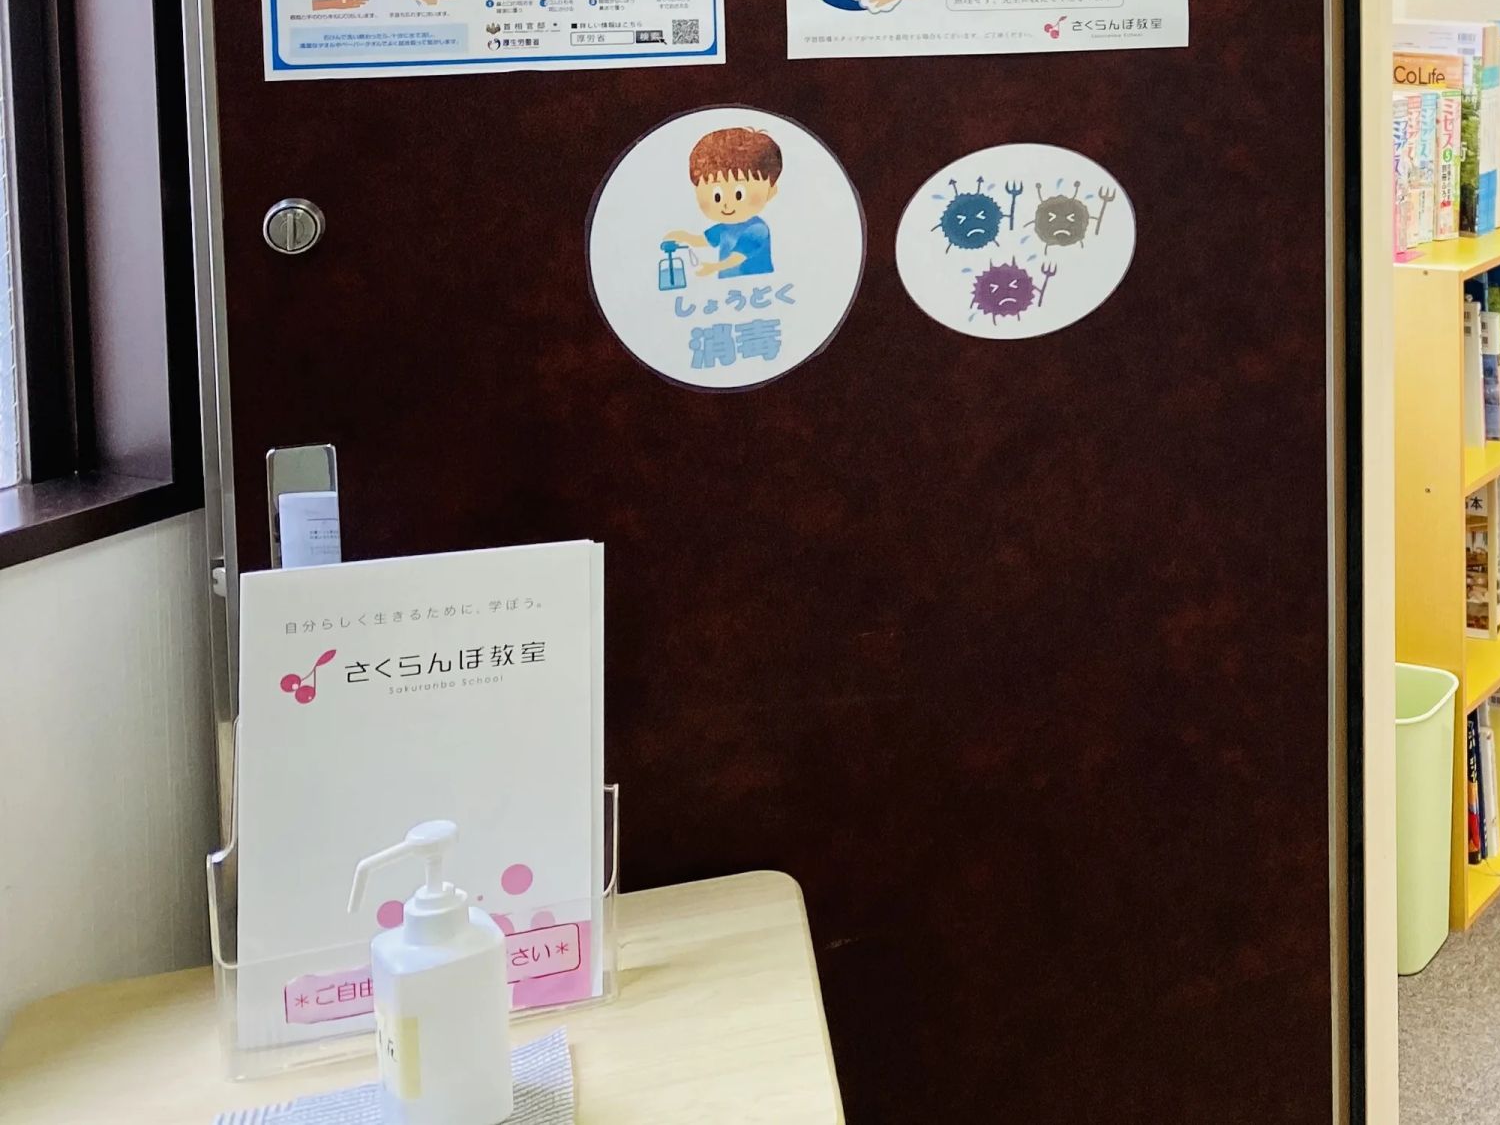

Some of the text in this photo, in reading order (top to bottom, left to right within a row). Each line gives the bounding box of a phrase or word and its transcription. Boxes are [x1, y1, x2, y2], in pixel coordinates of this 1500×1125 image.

[576, 34, 605, 43] 厚労省
[1071, 18, 1163, 31] さくらんぼ教室
[674, 283, 796, 318] しょうどく
[689, 318, 782, 369] 消毒
[285, 596, 544, 635] 自分らしく生きるために、学ぼう。
[345, 641, 547, 684] さくらんぼ教室
[388, 674, 504, 696] Sakuranbo School
